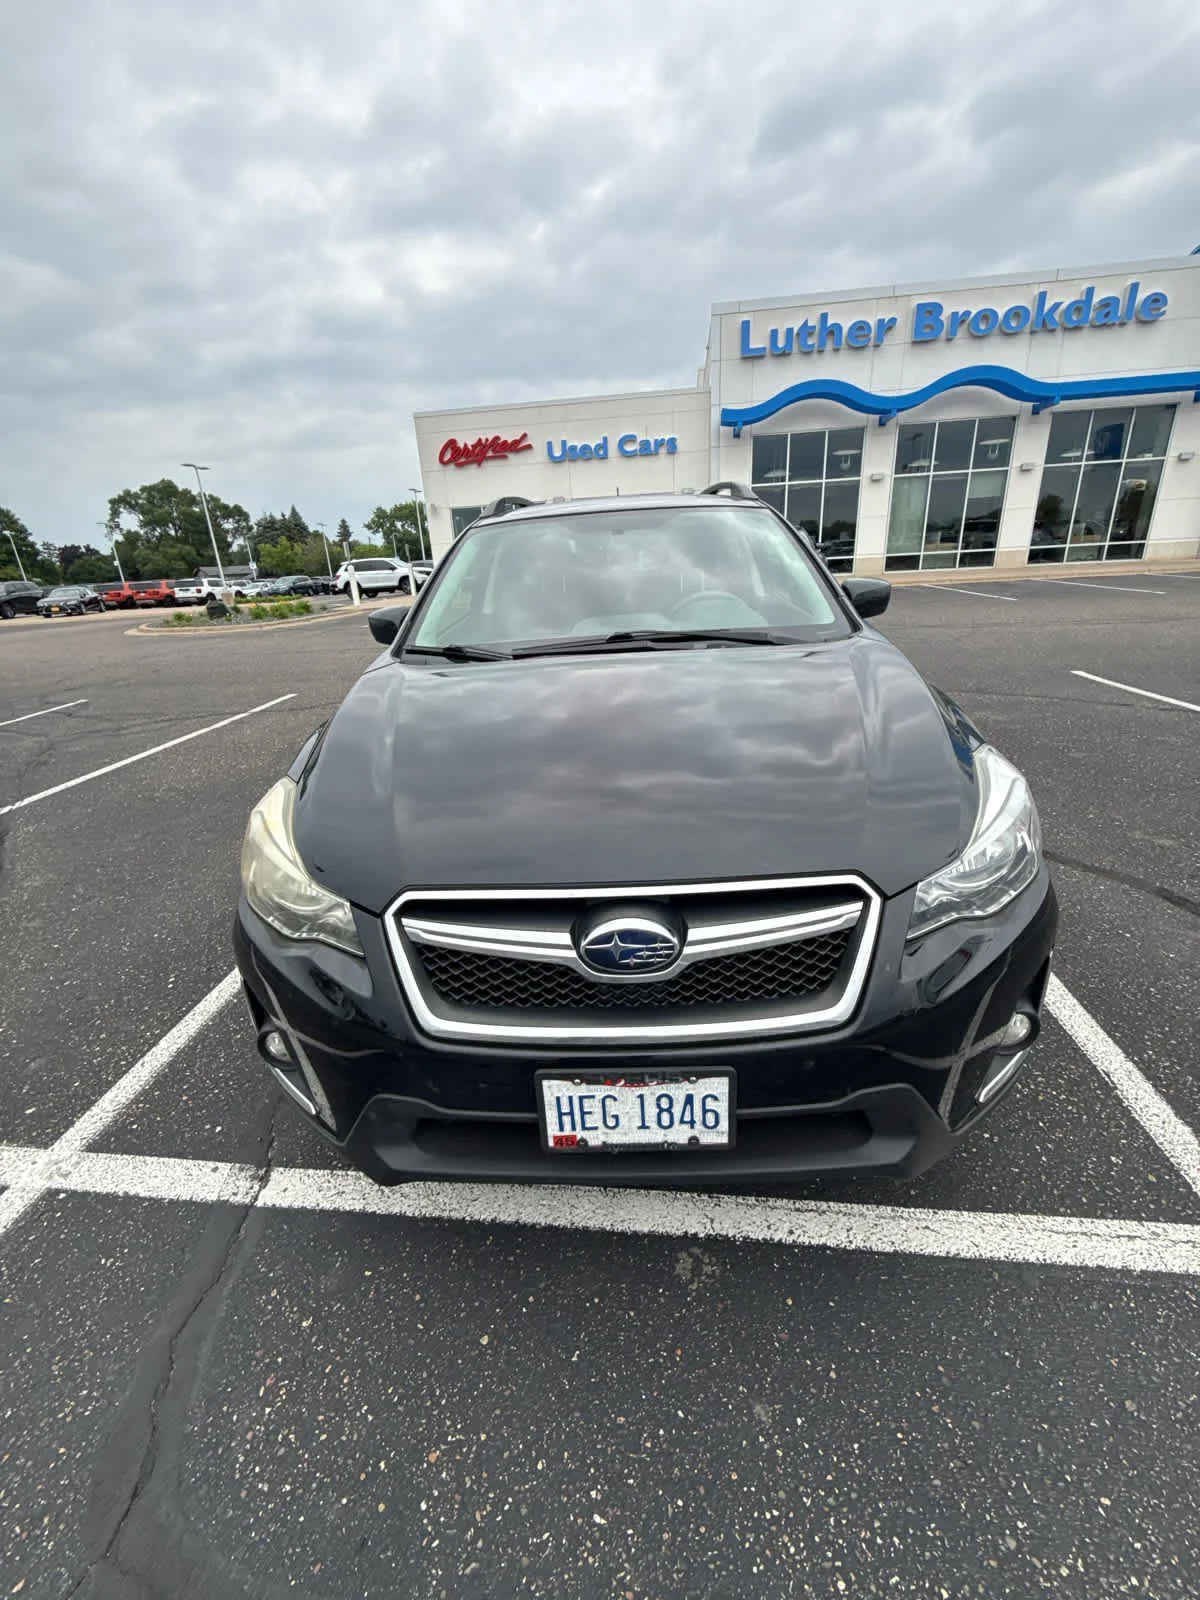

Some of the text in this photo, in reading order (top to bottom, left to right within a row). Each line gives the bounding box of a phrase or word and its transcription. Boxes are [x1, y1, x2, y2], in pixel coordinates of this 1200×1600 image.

[740, 282, 1168, 358] Luther Brookdale
[439, 432, 677, 467] Certified Used Cars
[556, 1093, 720, 1132] HEG 1846
